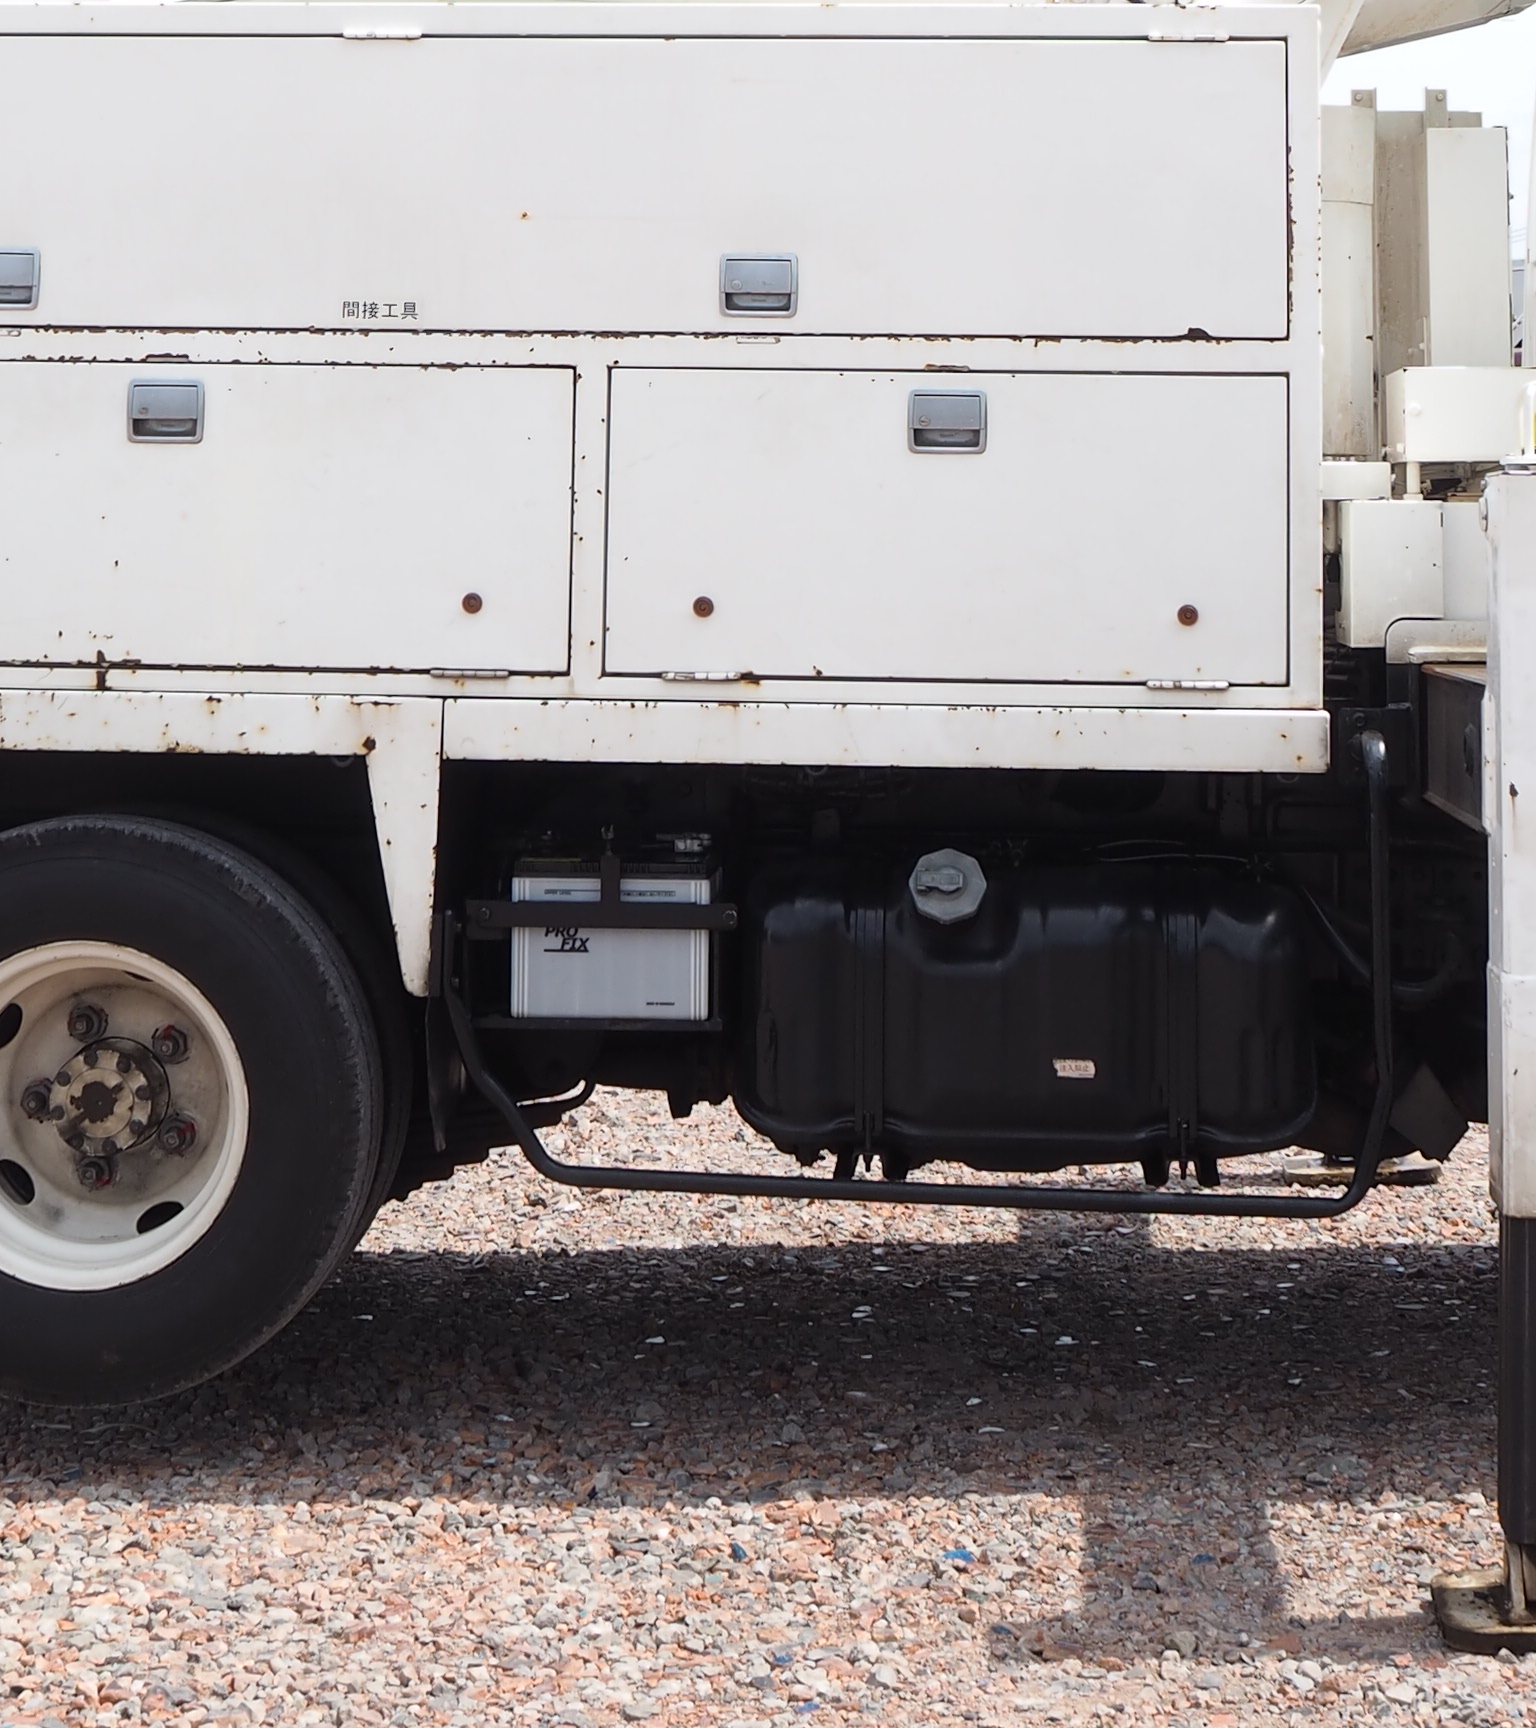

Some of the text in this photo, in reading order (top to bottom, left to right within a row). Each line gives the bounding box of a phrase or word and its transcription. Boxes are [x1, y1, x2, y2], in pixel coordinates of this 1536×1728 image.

[341, 300, 419, 320] 間接工具
[544, 927, 579, 938] PRO
[560, 937, 590, 952] FIX
